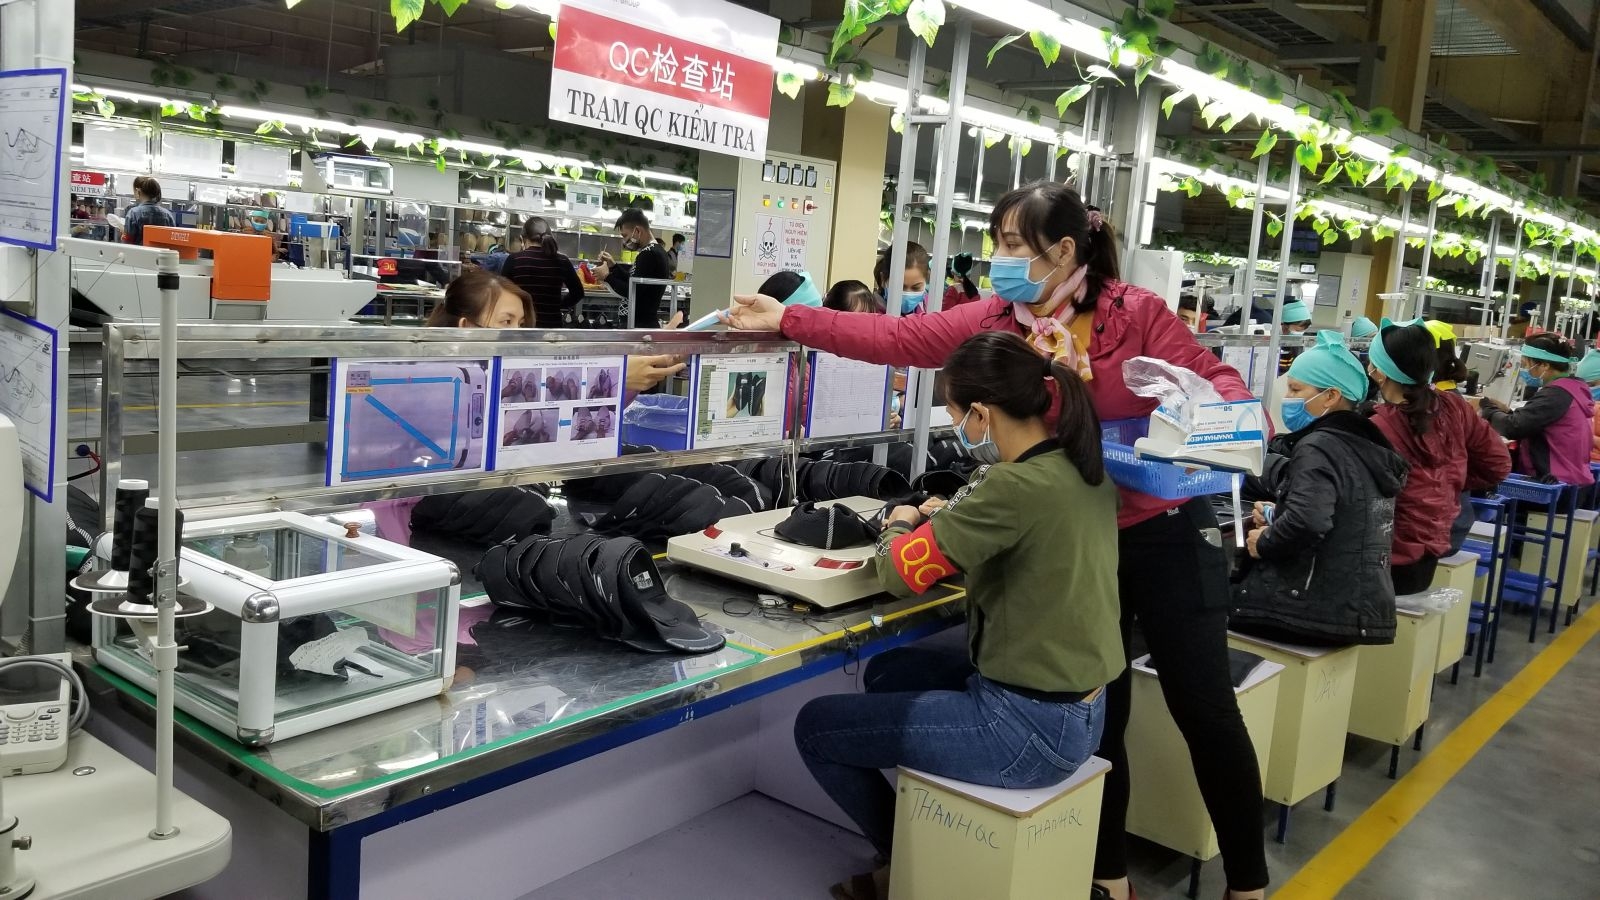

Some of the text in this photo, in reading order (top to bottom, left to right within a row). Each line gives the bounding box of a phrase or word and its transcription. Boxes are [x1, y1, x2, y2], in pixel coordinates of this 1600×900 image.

[609, 41, 736, 101] QC检查站
[567, 88, 756, 152] TRẠM QC KIỂM TRA
[900, 537, 947, 587] QC
